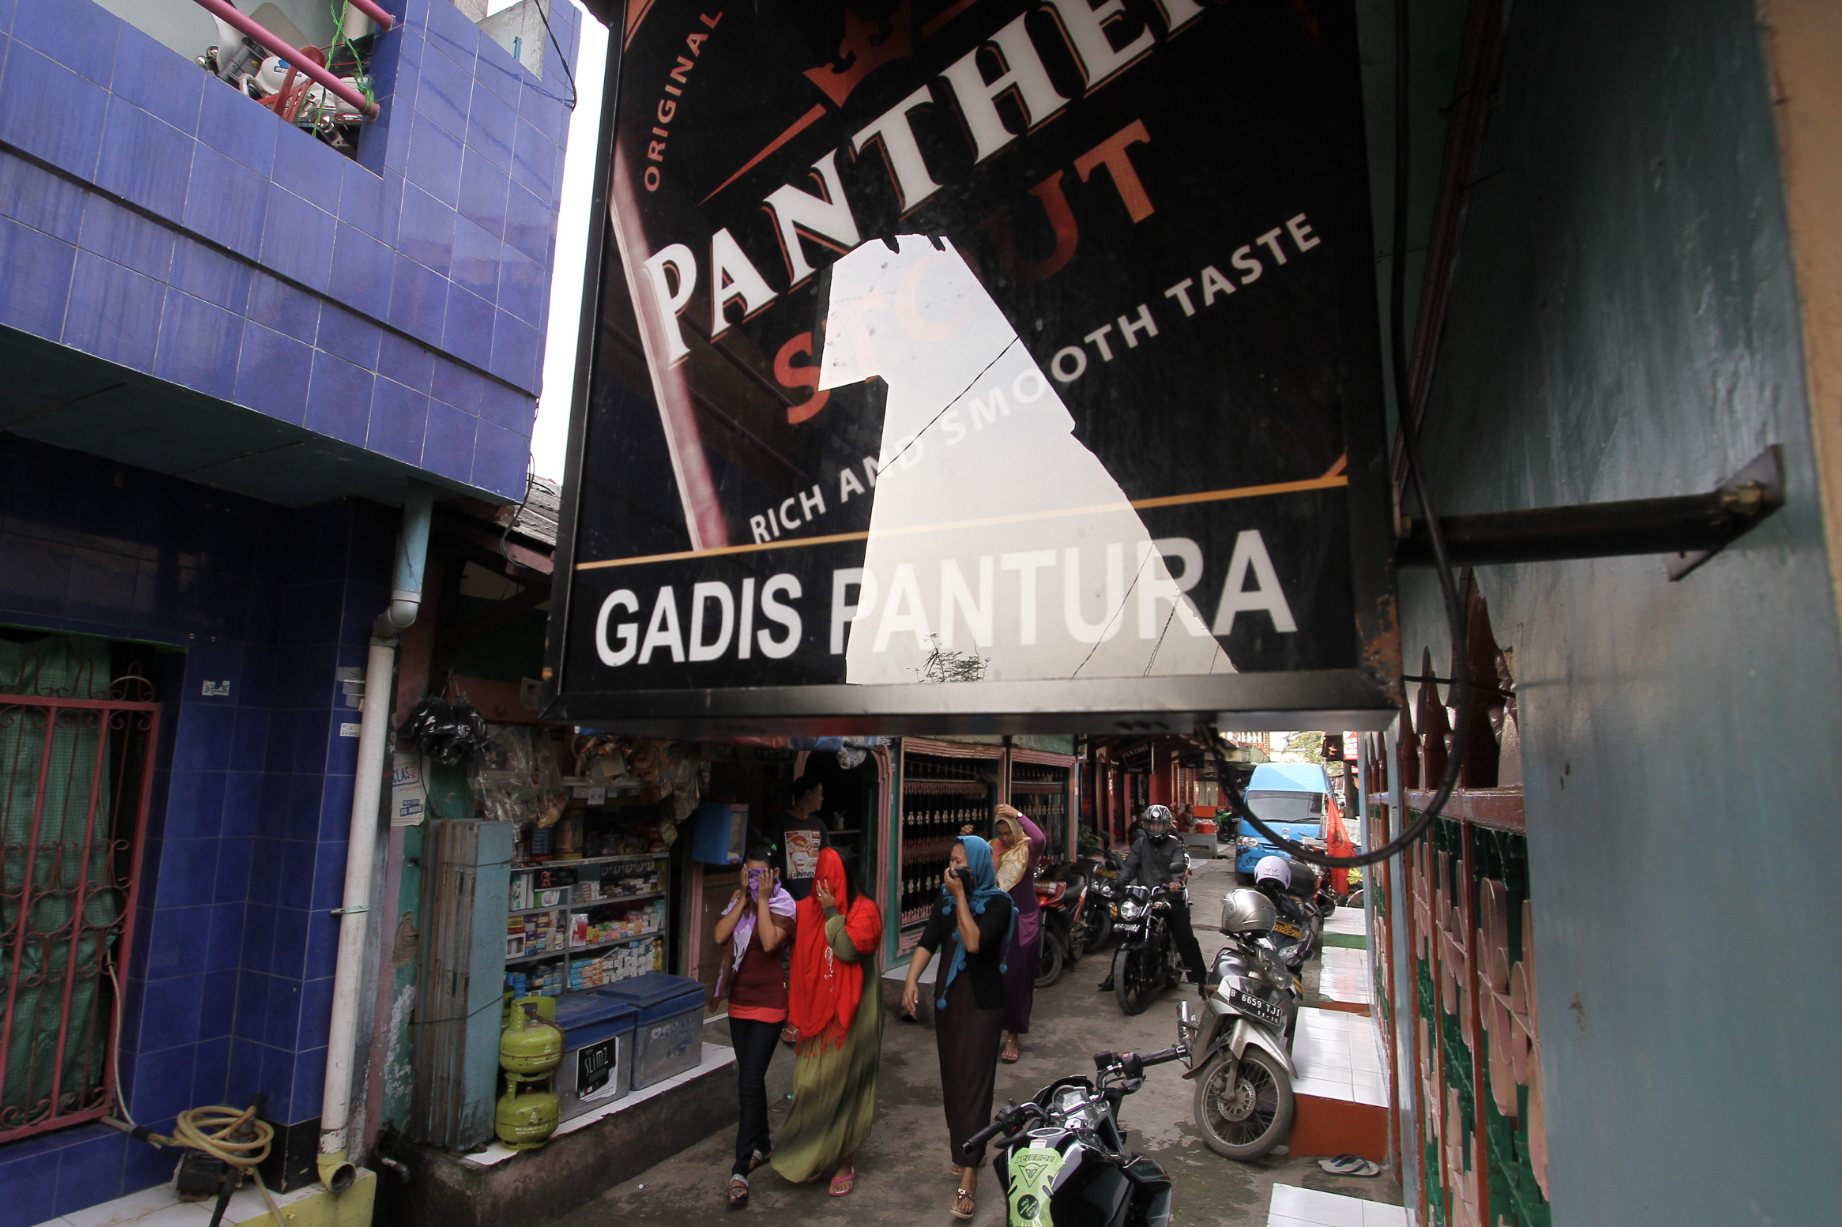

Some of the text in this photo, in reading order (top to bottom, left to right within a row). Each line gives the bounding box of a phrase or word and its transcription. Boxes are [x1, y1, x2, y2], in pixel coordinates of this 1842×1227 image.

[642, 0, 1206, 365] PANTHE
[643, 9, 724, 193] ORIGINAL
[749, 212, 1322, 544] RICH AND SMOOTH TASTE
[594, 529, 1299, 667] GADIS PANTURA
[1241, 994, 1261, 1008] 6659
